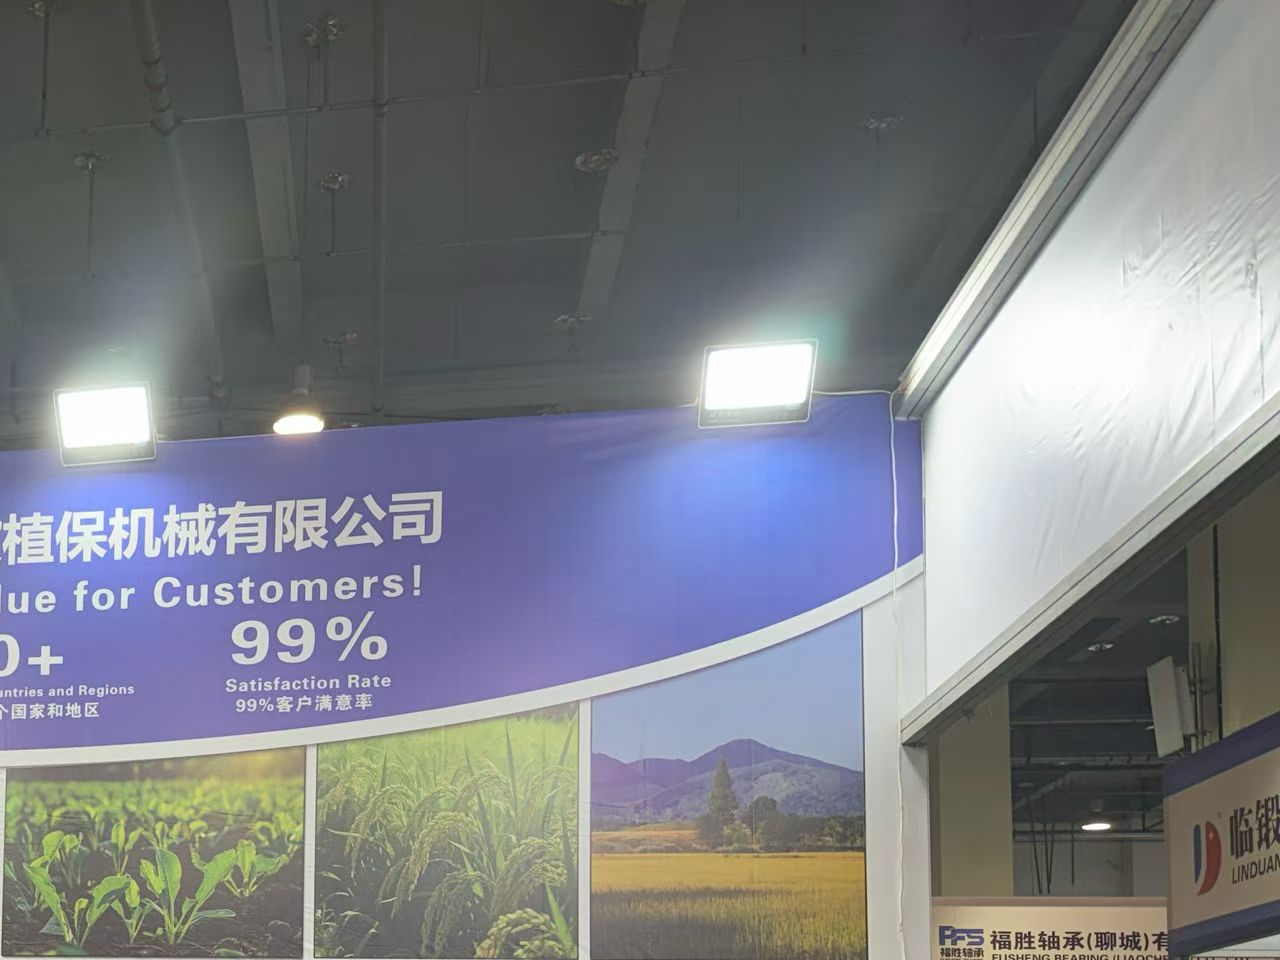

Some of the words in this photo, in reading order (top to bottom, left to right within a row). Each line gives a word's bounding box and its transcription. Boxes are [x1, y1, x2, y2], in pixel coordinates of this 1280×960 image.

[73, 579, 135, 611] for
[153, 564, 422, 608] Customers!
[231, 610, 388, 665] 99%
[48, 686, 73, 697] and
[78, 684, 135, 697] Regions
[225, 676, 340, 693] Satisfaction
[347, 673, 392, 689] Rate
[235, 693, 373, 713] 99%客户满意率
[938, 926, 985, 946] PFS
